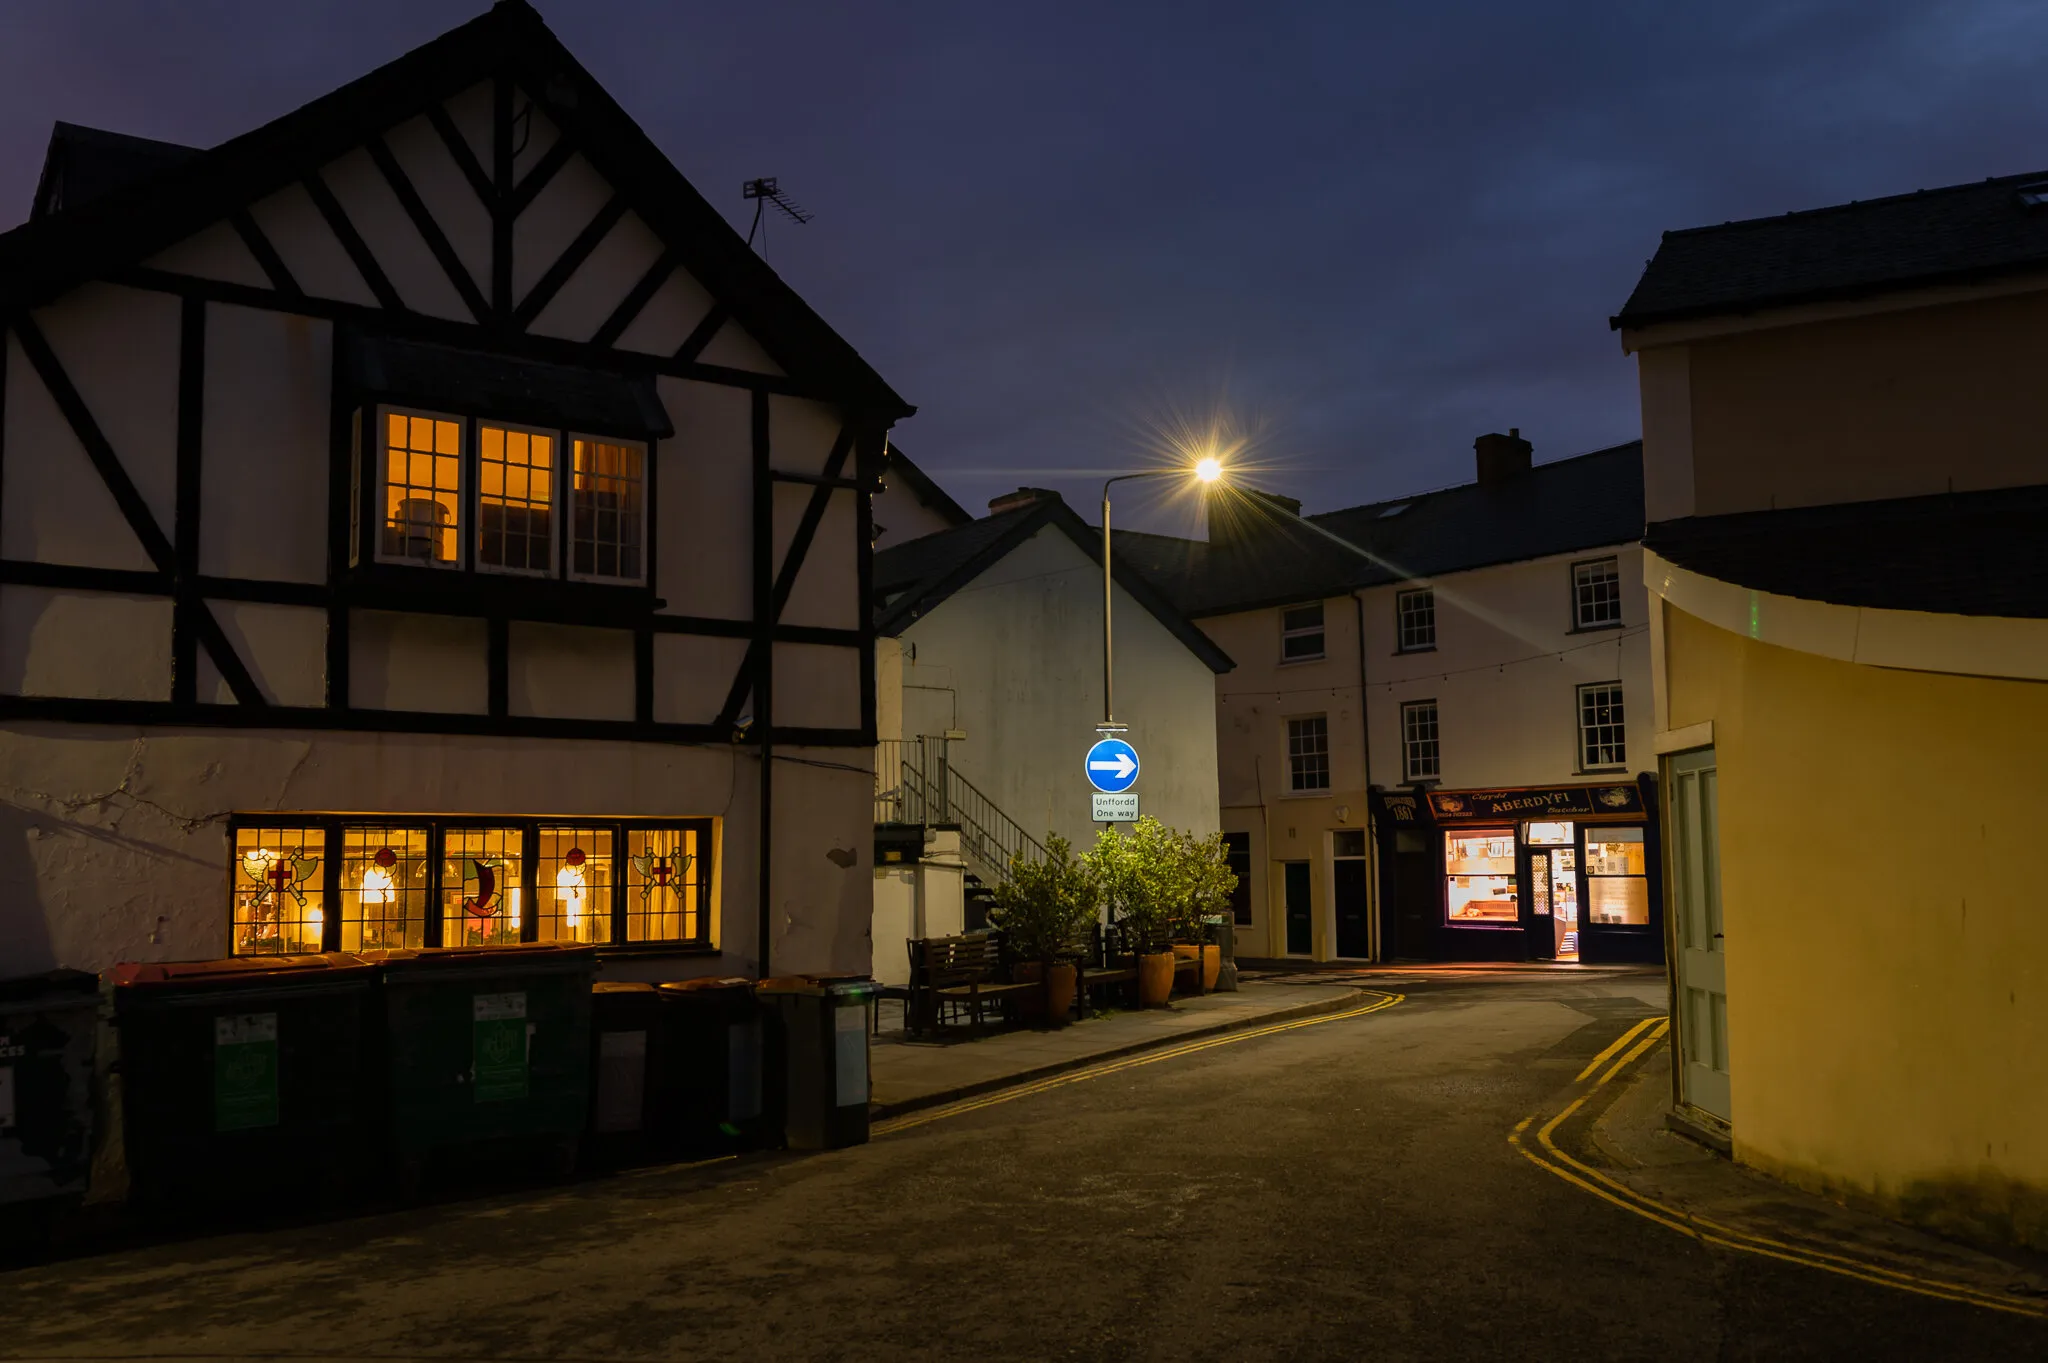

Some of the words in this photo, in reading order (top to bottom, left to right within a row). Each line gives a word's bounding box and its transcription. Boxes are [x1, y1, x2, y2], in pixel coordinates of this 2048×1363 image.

[1096, 798, 1135, 806] Unffordd
[1492, 792, 1571, 813] ABERDYFI
[1096, 809, 1114, 817] One
[1393, 804, 1415, 820] 1861
